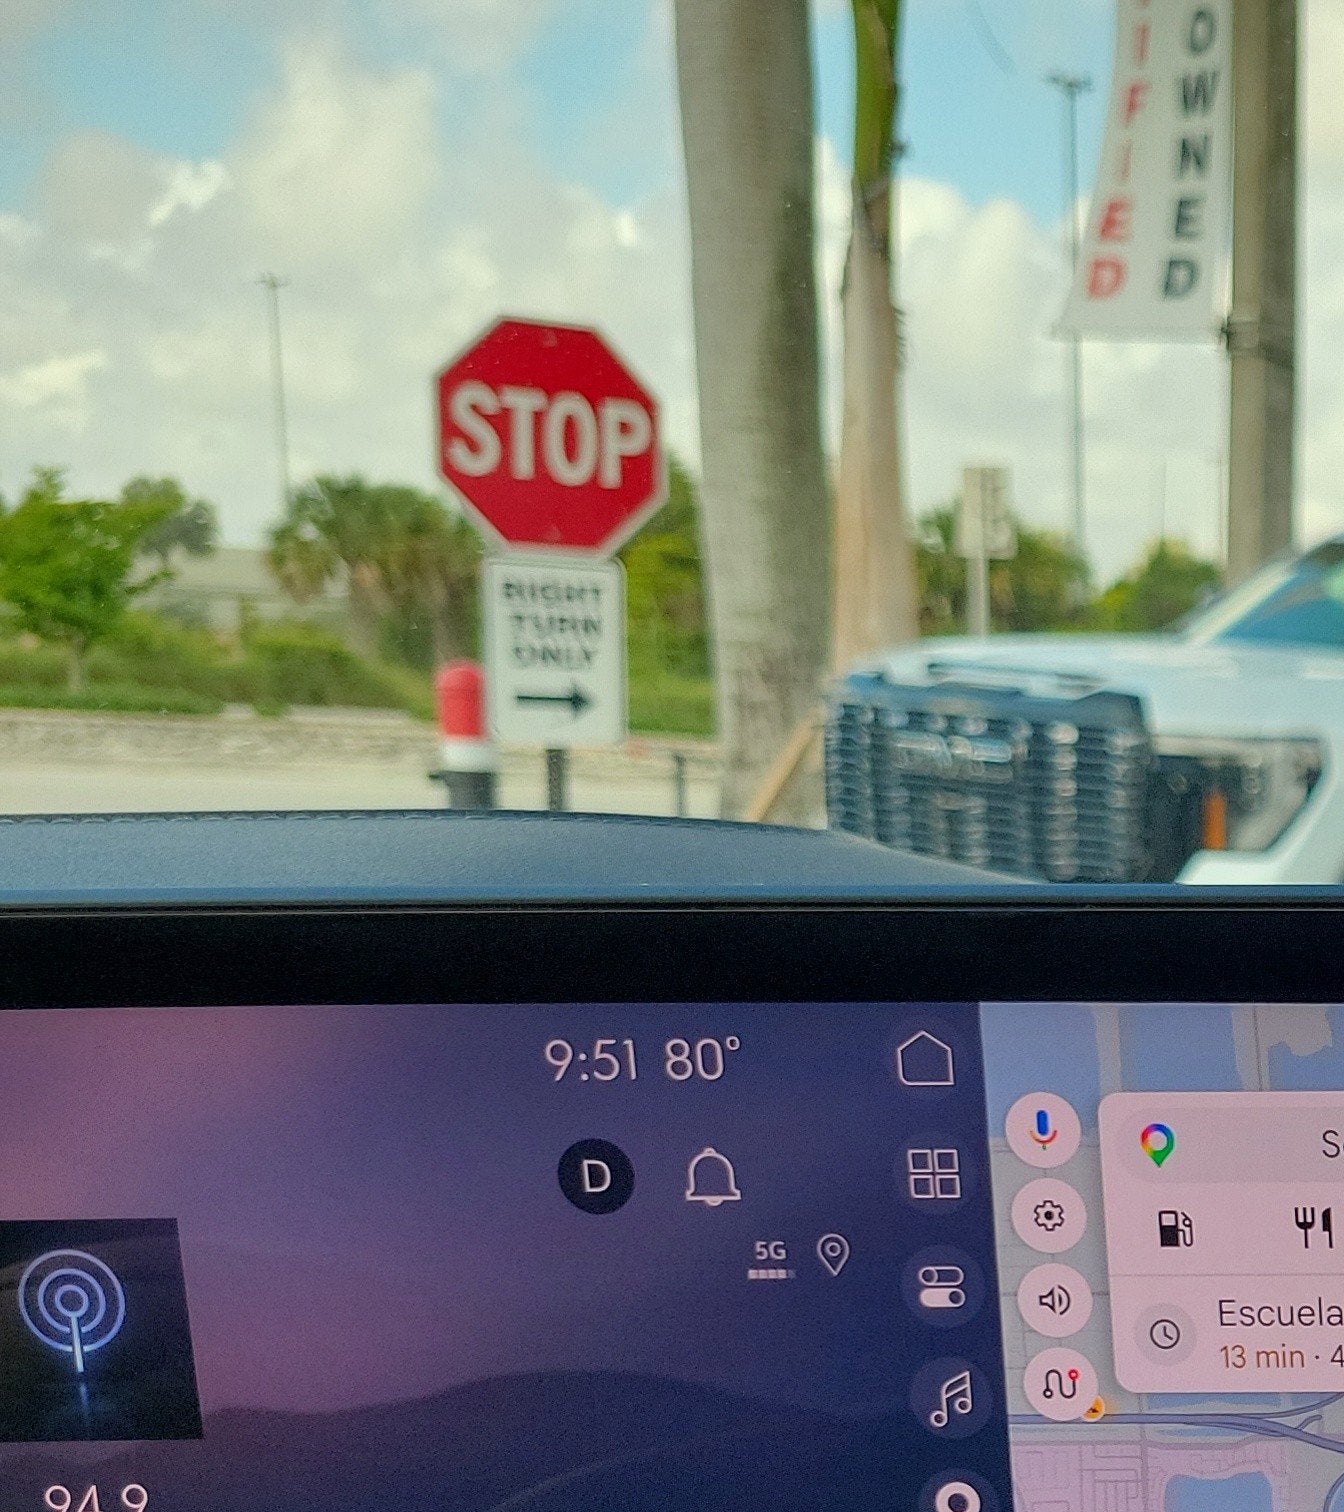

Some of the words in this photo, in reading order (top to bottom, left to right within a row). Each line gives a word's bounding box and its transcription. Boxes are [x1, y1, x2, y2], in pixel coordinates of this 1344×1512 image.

[1084, 0, 1150, 302] IFIED
[1161, 7, 1219, 300] OWNED
[448, 382, 652, 490] STOP
[510, 612, 602, 638] TURN
[512, 645, 597, 671] ONLY
[545, 1038, 638, 1082] 9:51
[664, 1035, 742, 1082] 80°
[581, 1158, 612, 1194] D
[754, 1240, 788, 1261] 5G
[1218, 1297, 1344, 1328] Escuela
[1219, 1345, 1247, 1369] 13
[1255, 1345, 1305, 1369] min
